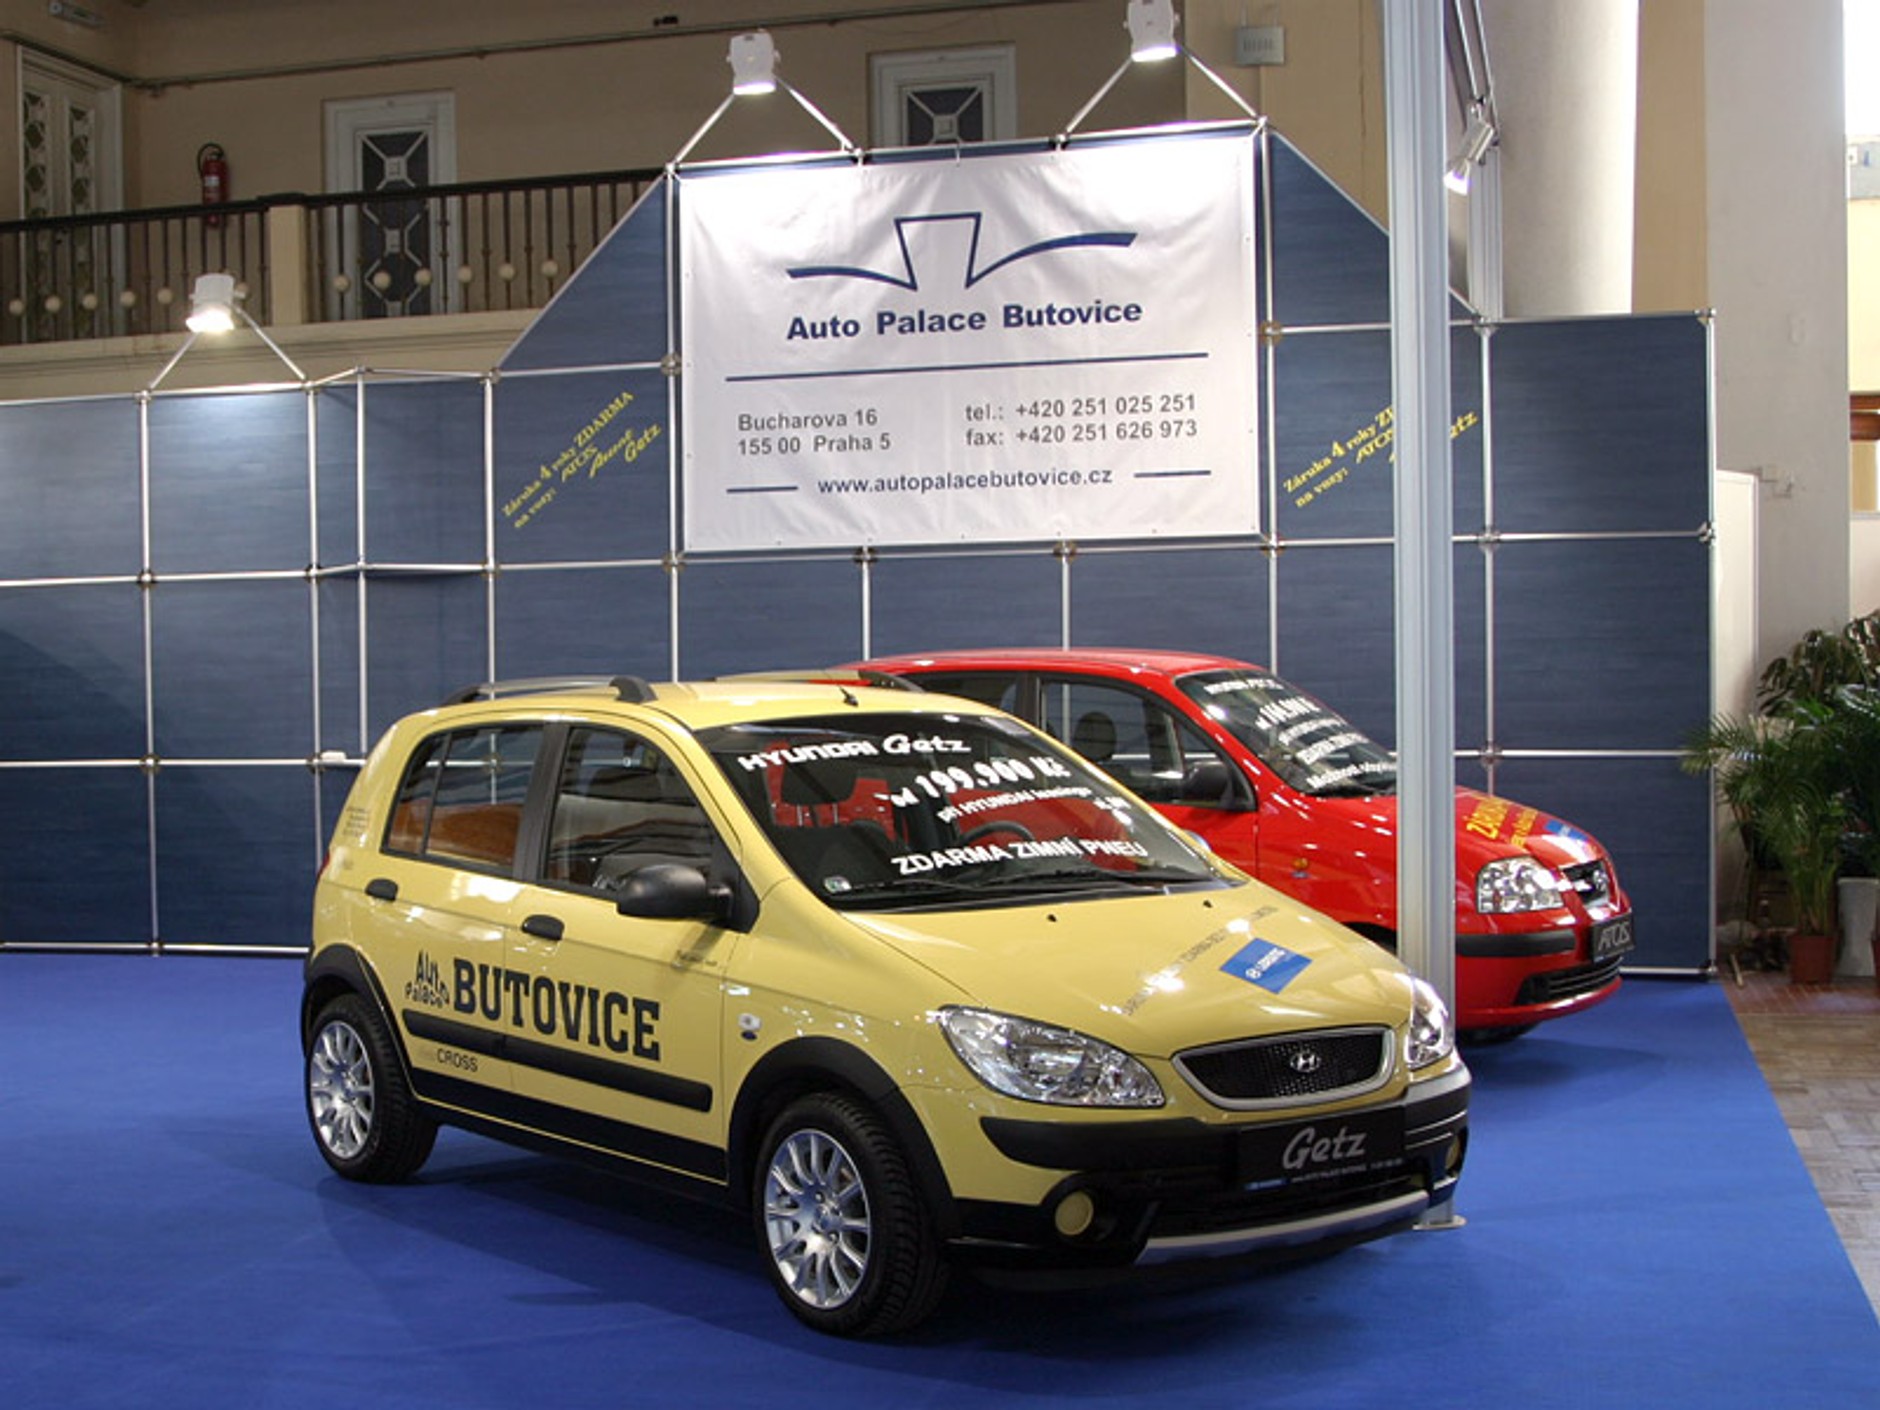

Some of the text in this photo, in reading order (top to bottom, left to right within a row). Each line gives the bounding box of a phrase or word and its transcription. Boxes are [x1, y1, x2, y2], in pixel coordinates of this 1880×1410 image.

[787, 299, 1143, 341] Auto Palace Butovice
[738, 408, 878, 432] Bucharova 16
[965, 394, 1195, 422] tel.: +420 251 025 251
[540, 464, 552, 479] 4
[574, 391, 634, 447] ZDARMA
[738, 432, 891, 456] 155 00 Praha 5
[965, 418, 1198, 447] fax: +420 251 626 973
[1283, 424, 1377, 493] Záruka 4 roky
[817, 469, 1112, 495] www.autopalacebutovice.cz
[1295, 492, 1314, 508] na
[737, 734, 971, 771] HYUNDAI Getz
[891, 837, 1148, 875] ZDARMA ZIMNÍ PNEU
[453, 957, 662, 1062] BUTOVICE
[436, 1047, 478, 1073] CROSS
[1282, 1125, 1367, 1169] Getz
